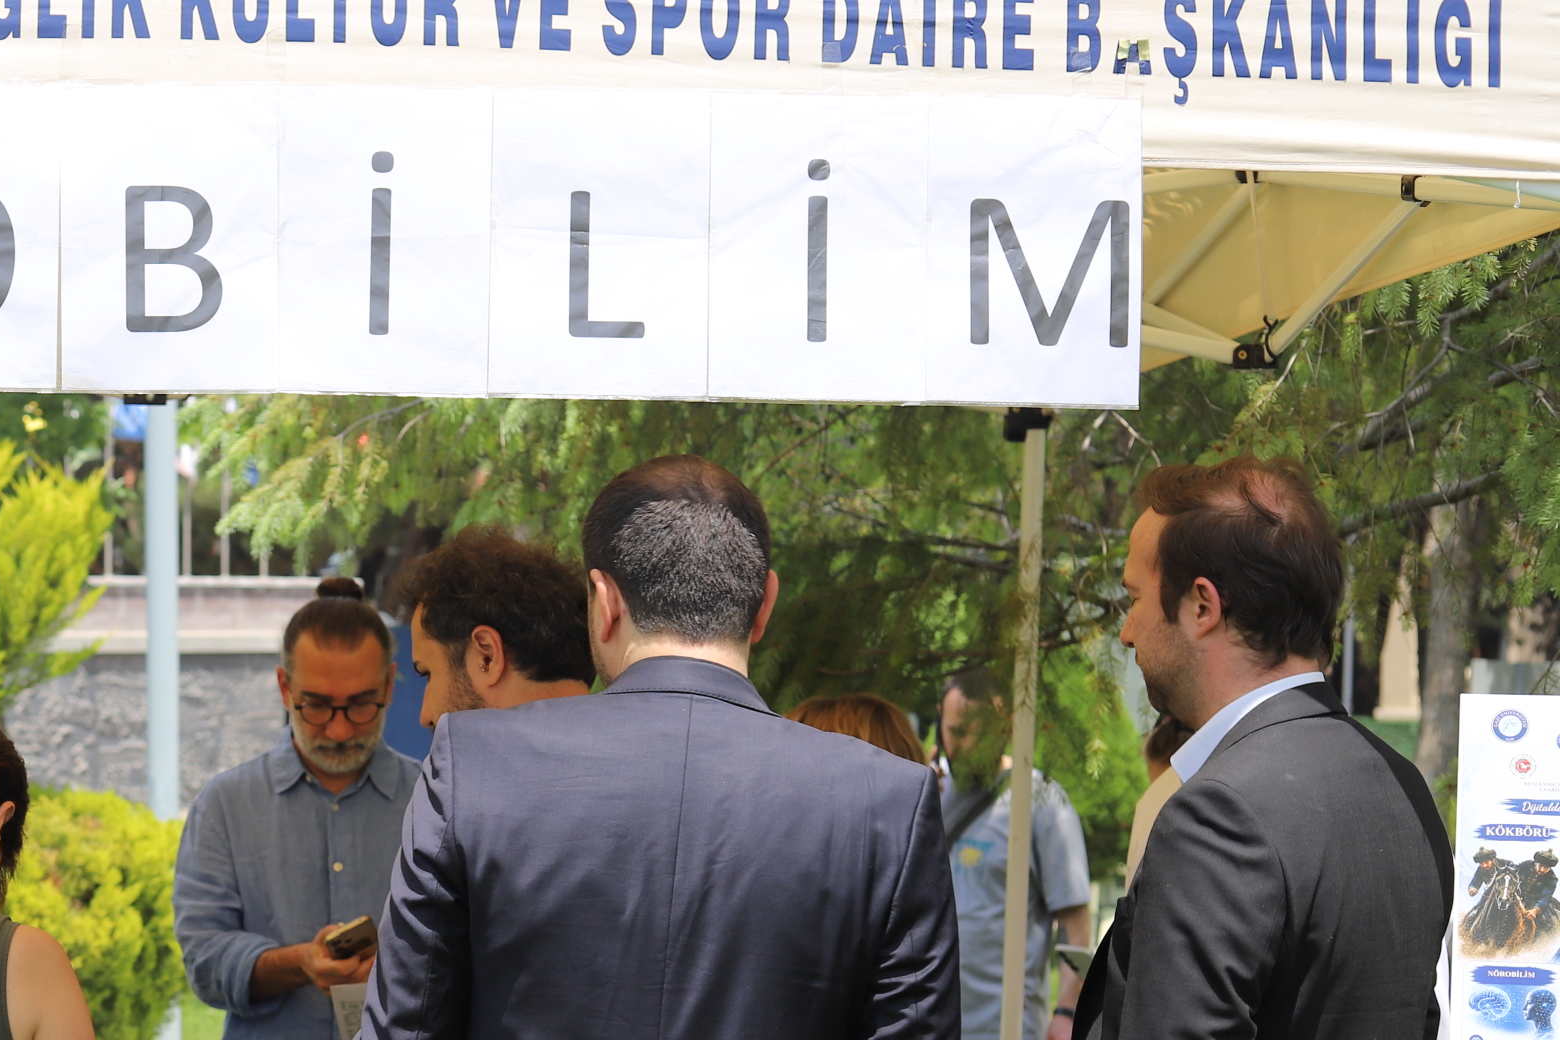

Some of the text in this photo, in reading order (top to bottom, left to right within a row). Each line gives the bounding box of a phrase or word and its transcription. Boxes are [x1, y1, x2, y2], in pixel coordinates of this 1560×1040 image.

[601, 0, 790, 60] SPOR
[1486, 825, 1551, 837] KÖKBÖRÜ
[1487, 970, 1536, 979] NÖROBİLİM
